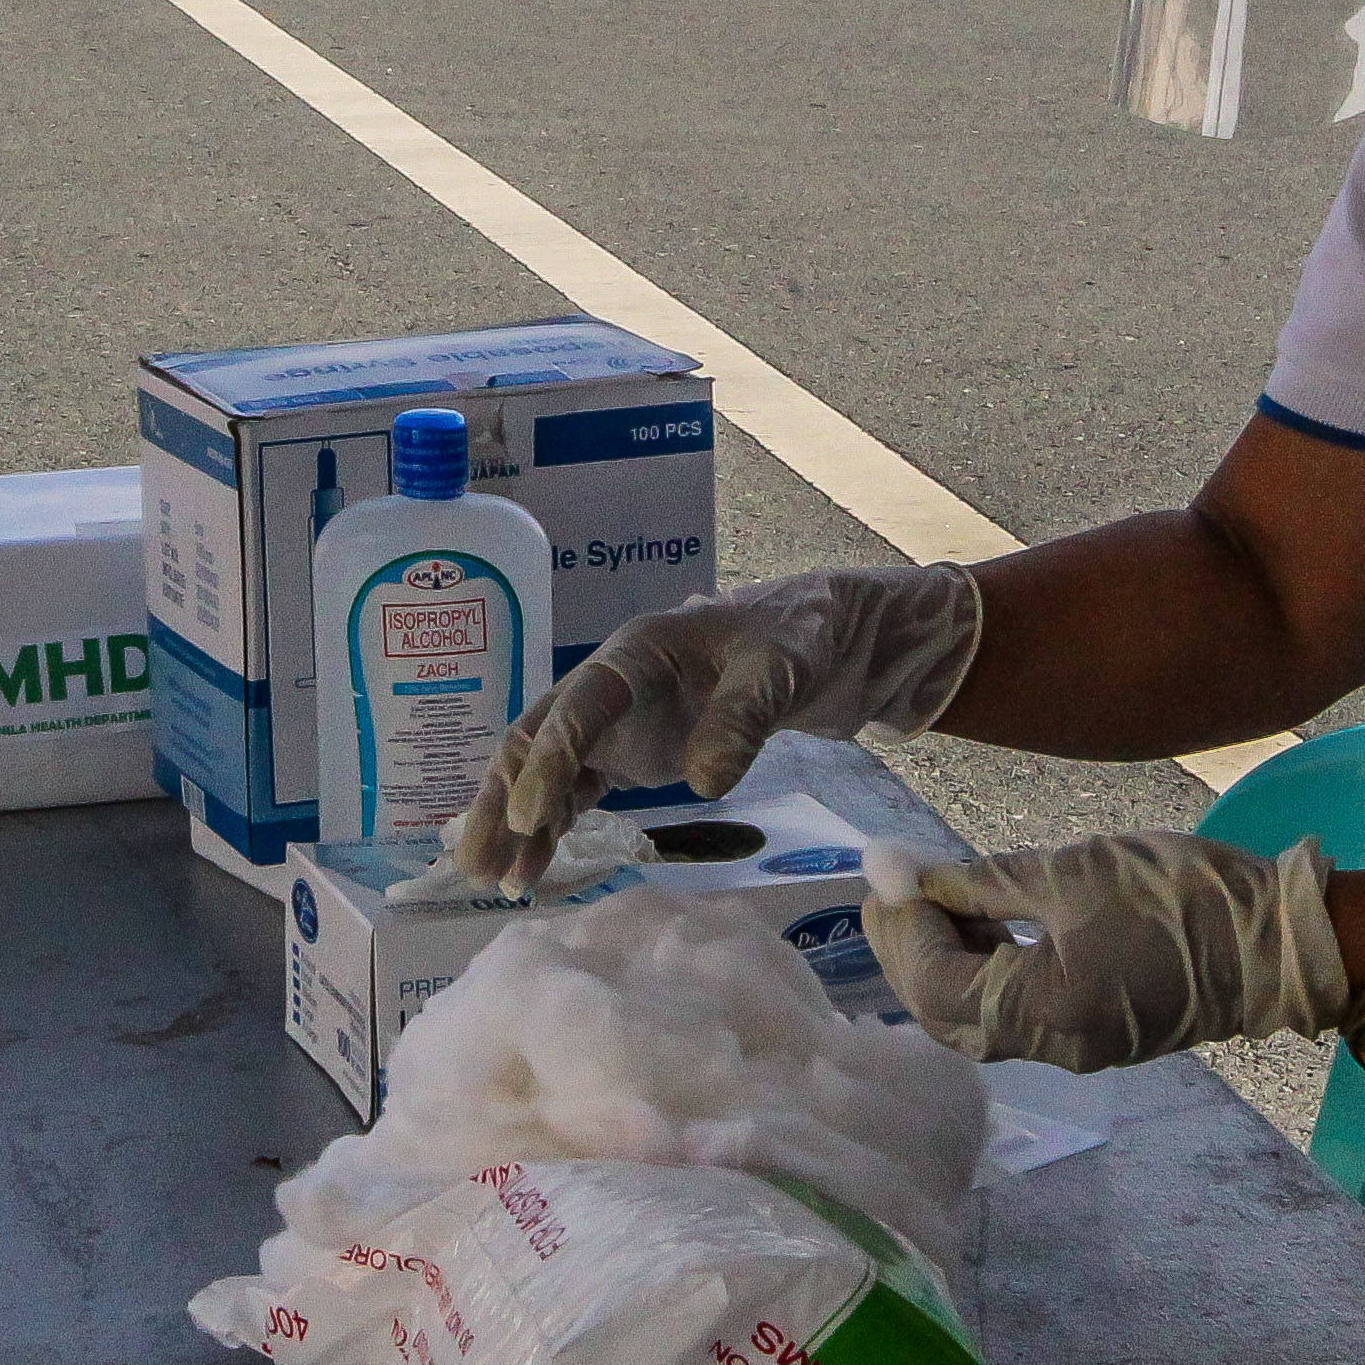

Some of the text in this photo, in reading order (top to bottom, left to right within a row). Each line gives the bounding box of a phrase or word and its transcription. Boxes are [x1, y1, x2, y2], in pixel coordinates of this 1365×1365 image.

[631, 421, 703, 441] 100 PCS
[587, 535, 701, 572] Syringe
[389, 609, 482, 631] ISOPROPYL
[401, 628, 474, 650] ALCOHOL
[31, 717, 83, 734] HEALTH
